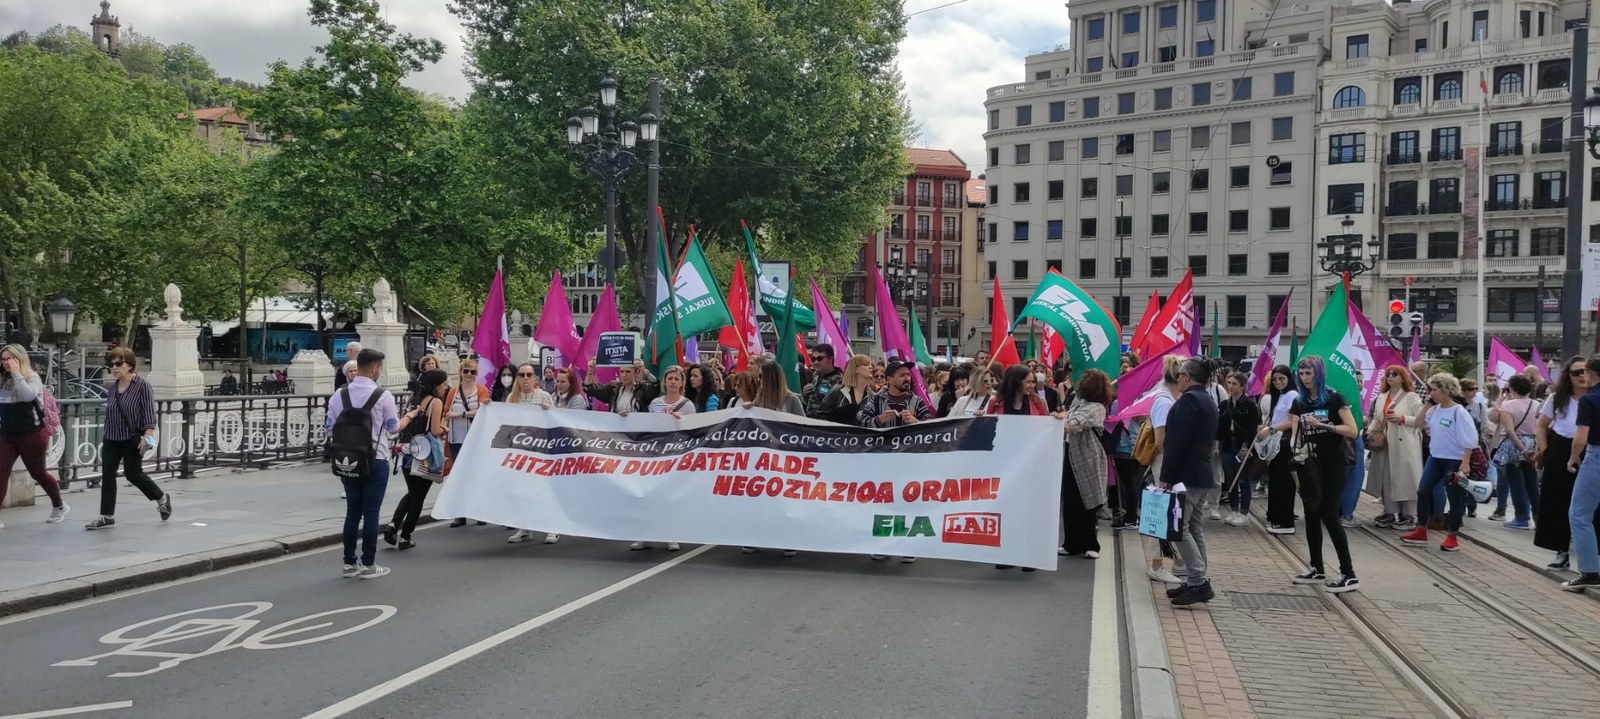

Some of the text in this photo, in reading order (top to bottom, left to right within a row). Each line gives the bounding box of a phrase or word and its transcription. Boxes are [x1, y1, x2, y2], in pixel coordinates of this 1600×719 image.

[1058, 310, 1092, 362] SINDIKATUA
[512, 432, 582, 448] Comercio
[585, 437, 611, 449] del
[779, 431, 859, 447] comercio
[864, 435, 885, 447] en
[891, 428, 959, 449] general
[501, 451, 821, 479] HITZARMEN DUIN BATEN ALDE,
[712, 475, 1001, 504] NEGOZIAZIOA ORAIN!
[872, 514, 997, 538] ELA LAB
